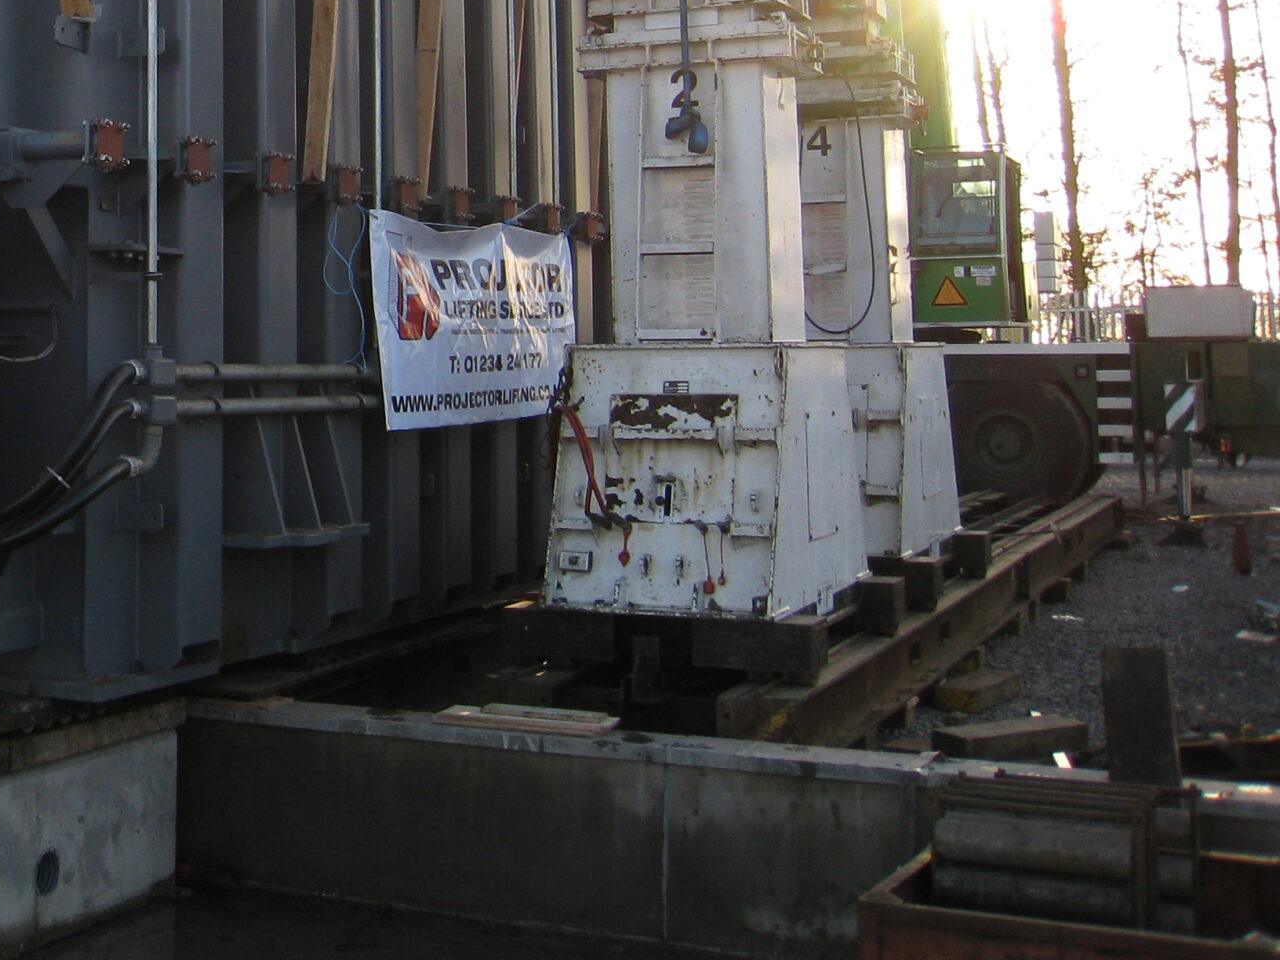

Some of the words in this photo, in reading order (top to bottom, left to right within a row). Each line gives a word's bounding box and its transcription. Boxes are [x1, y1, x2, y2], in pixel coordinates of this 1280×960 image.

[671, 69, 699, 108] 2
[806, 125, 832, 157] 4
[449, 355, 460, 374] T:
[464, 354, 503, 373] 01234
